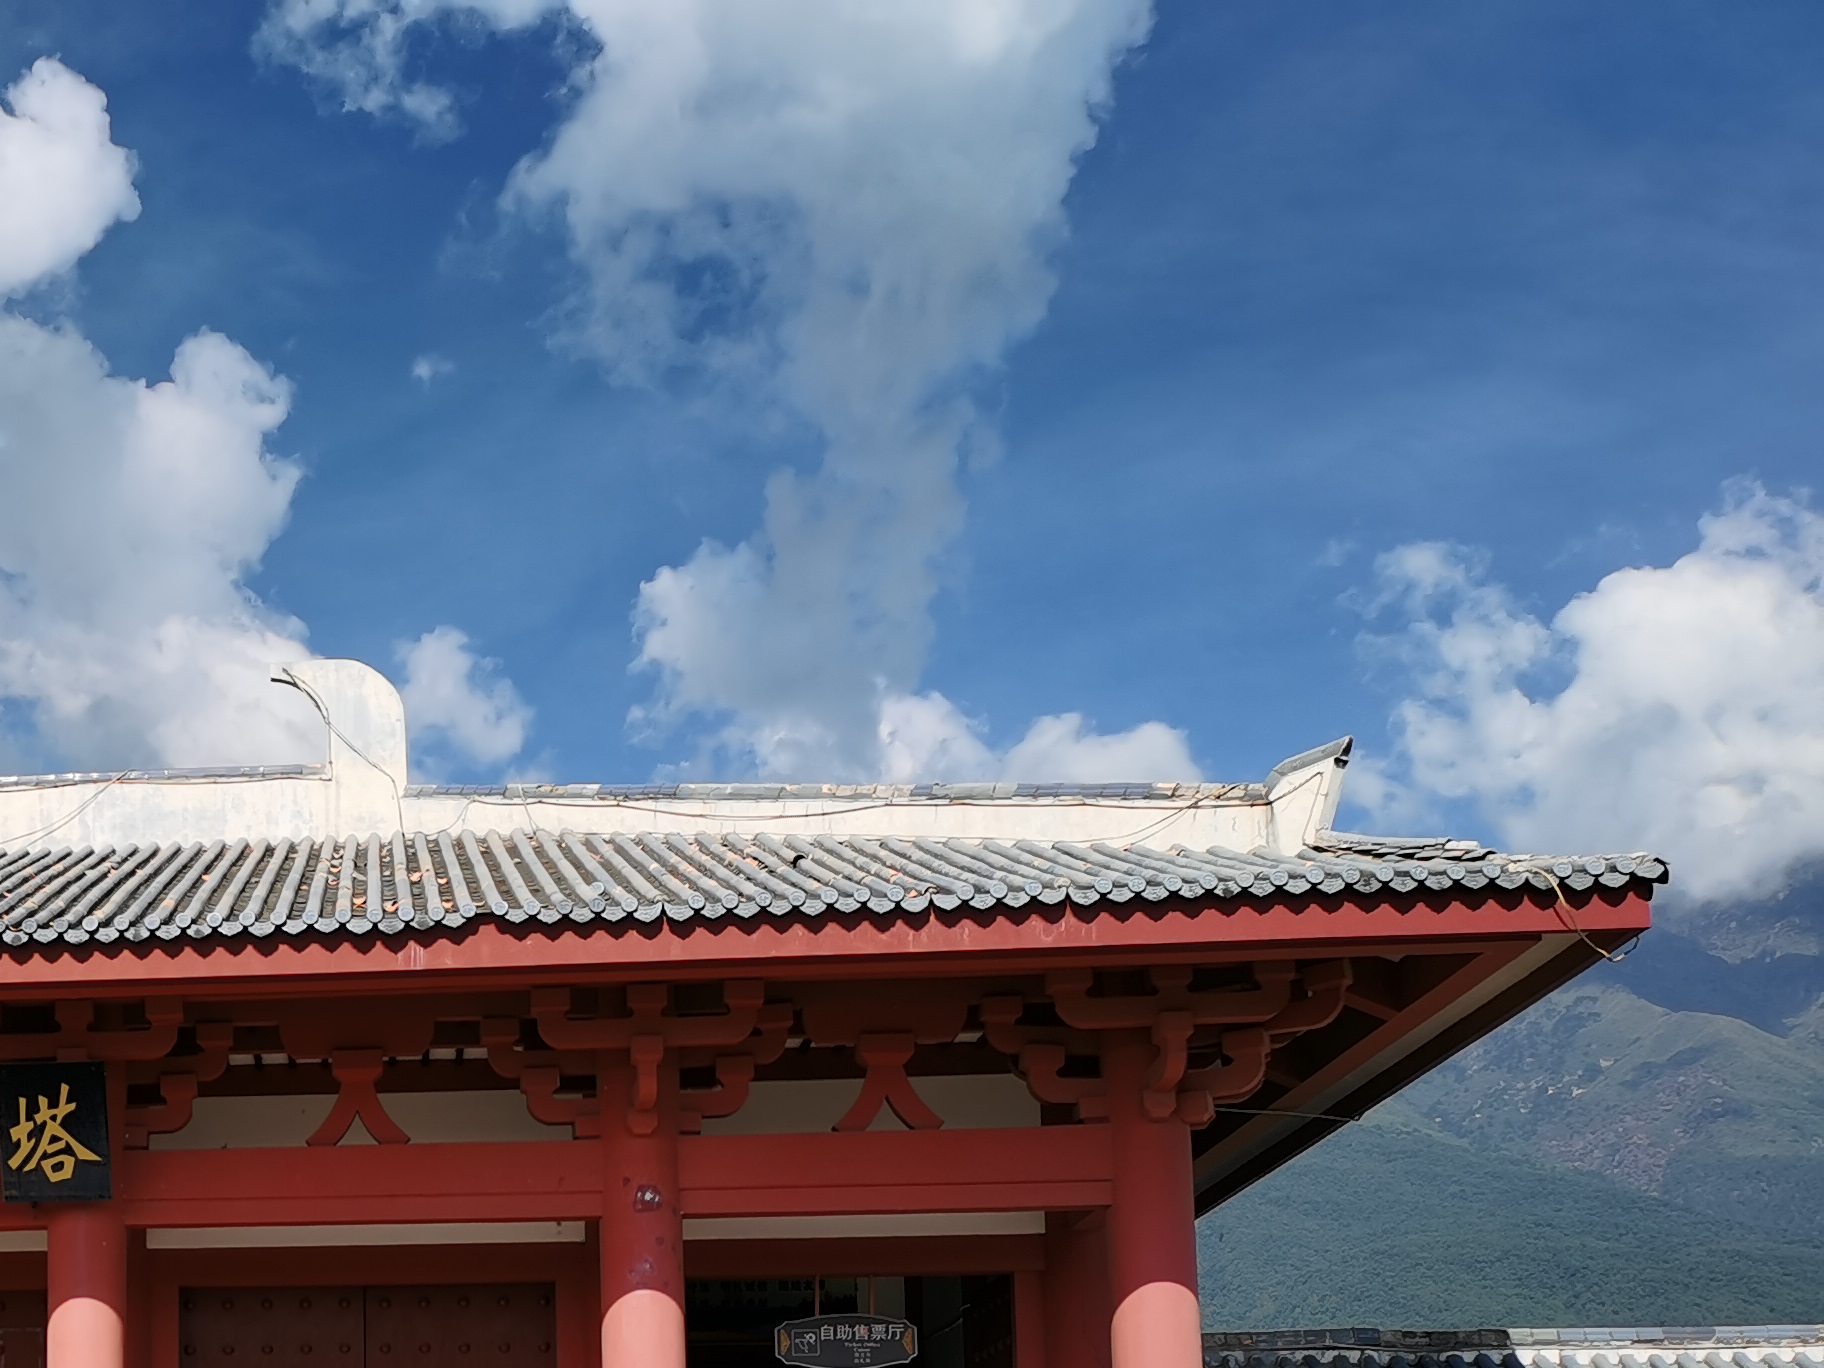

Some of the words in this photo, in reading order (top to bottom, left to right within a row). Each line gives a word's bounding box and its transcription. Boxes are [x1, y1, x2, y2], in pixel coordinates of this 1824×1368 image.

[820, 1323, 905, 1341] 自助售票厅
